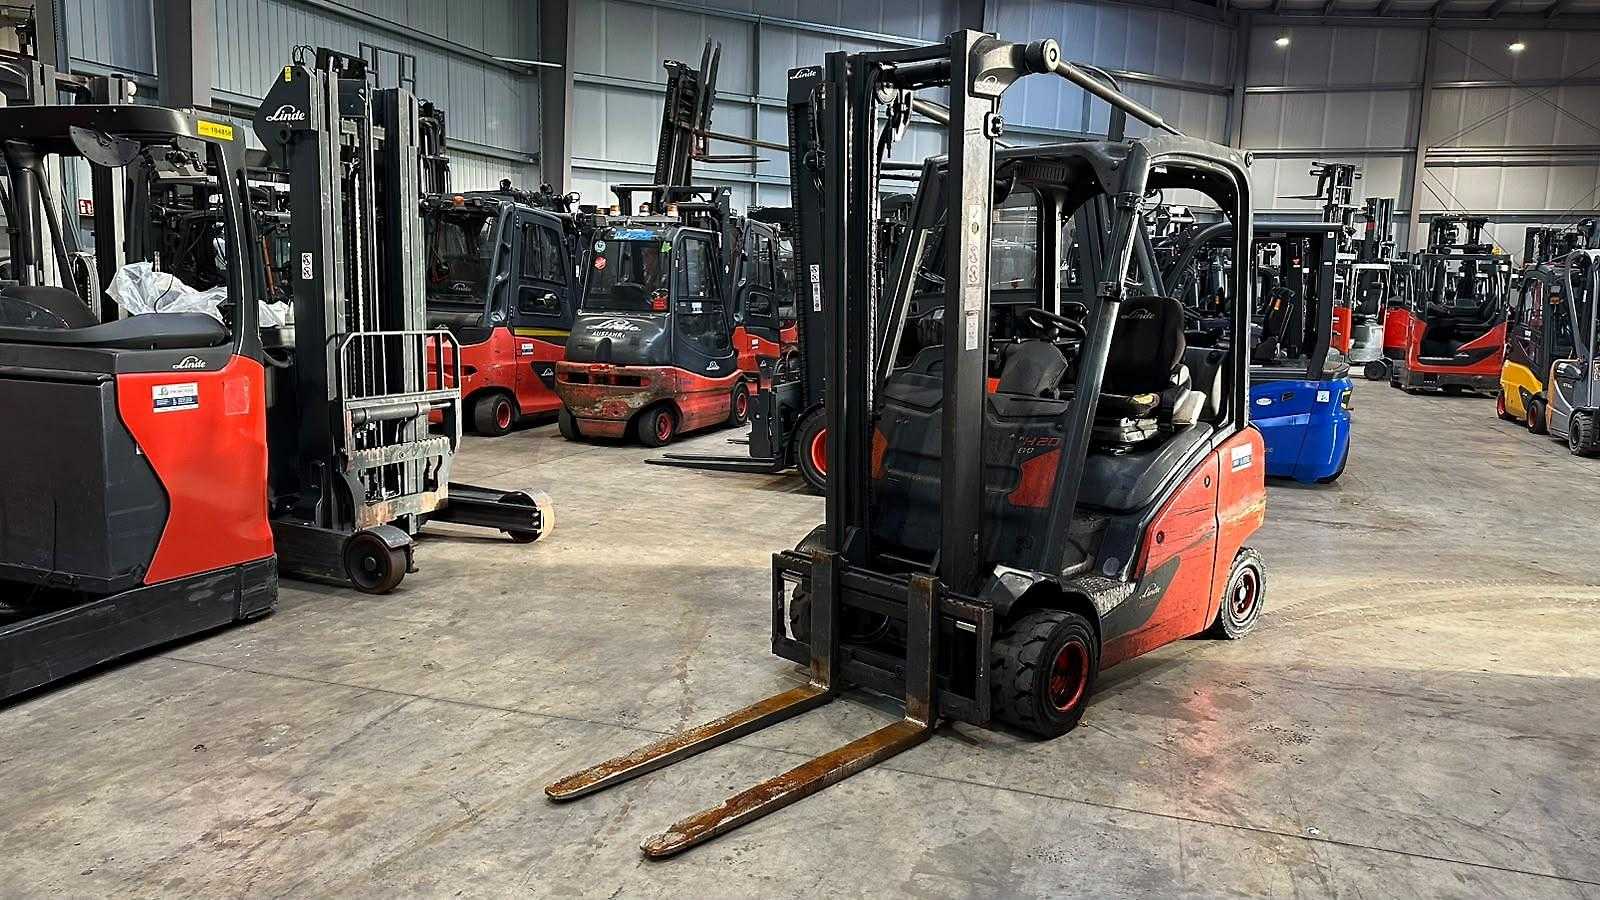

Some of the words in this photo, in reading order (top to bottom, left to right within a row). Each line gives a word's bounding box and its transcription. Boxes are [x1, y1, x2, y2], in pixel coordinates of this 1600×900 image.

[789, 69, 817, 79] Linde
[265, 104, 306, 121] Linde
[172, 355, 206, 369] Linde
